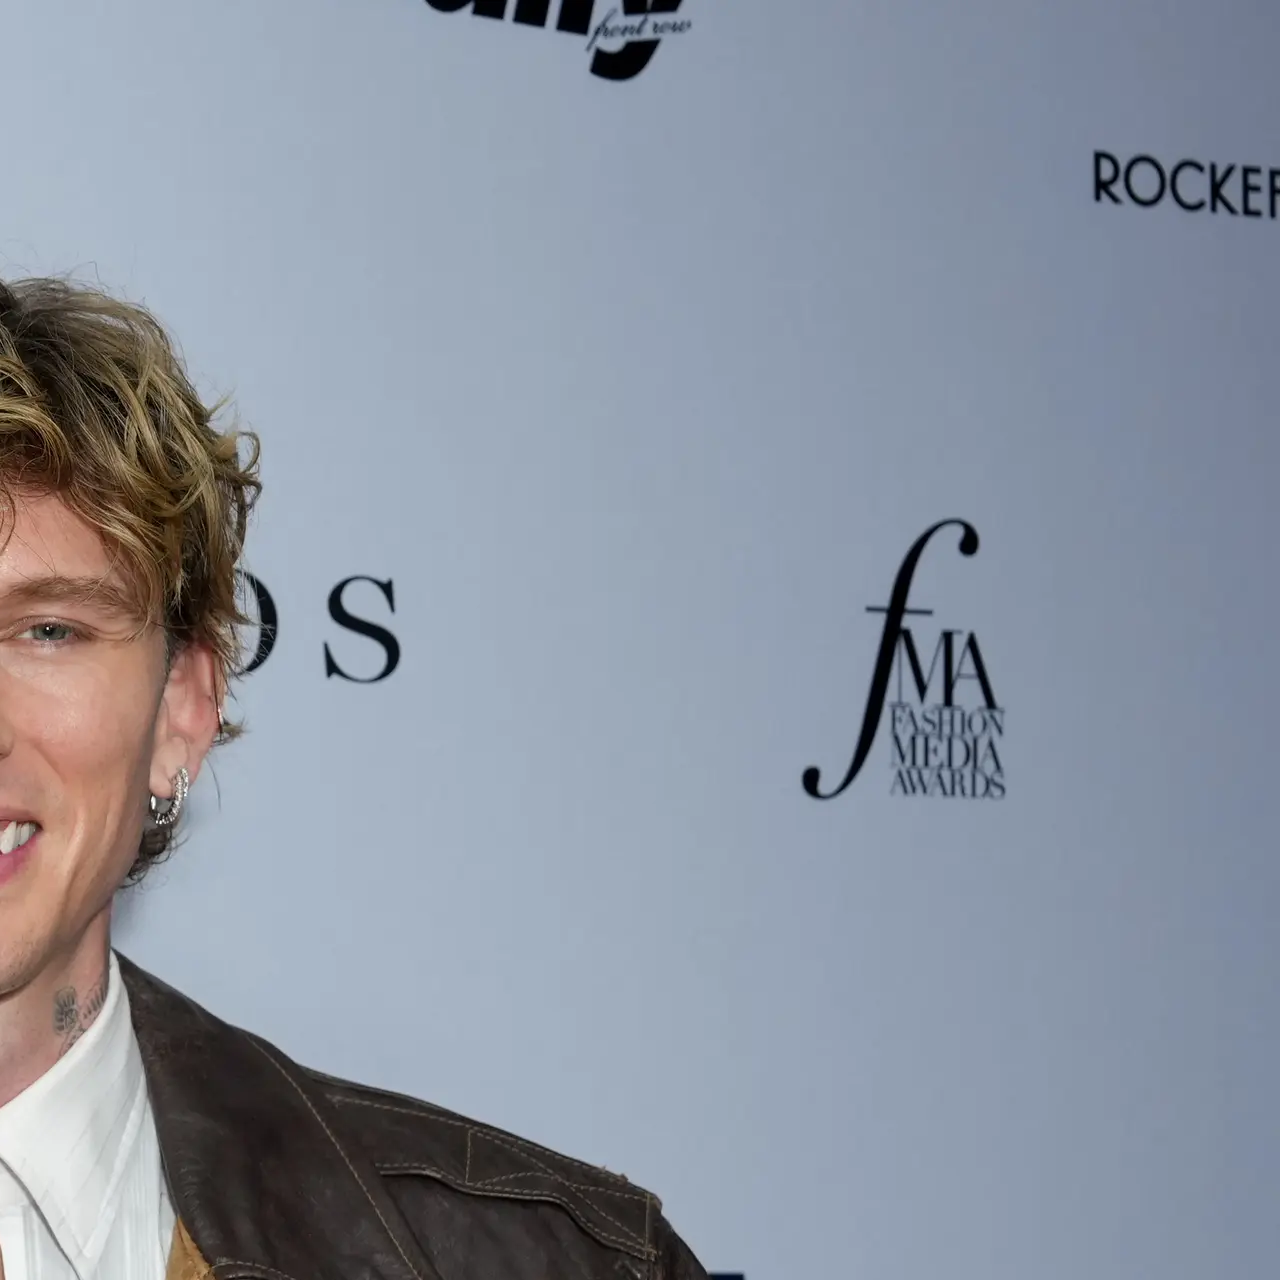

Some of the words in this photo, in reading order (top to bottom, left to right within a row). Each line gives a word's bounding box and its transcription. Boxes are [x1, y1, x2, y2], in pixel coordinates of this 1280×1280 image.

[890, 703, 1007, 738] FASHION
[890, 733, 1005, 775] MEDIA
[889, 766, 1007, 800] AWARDS
